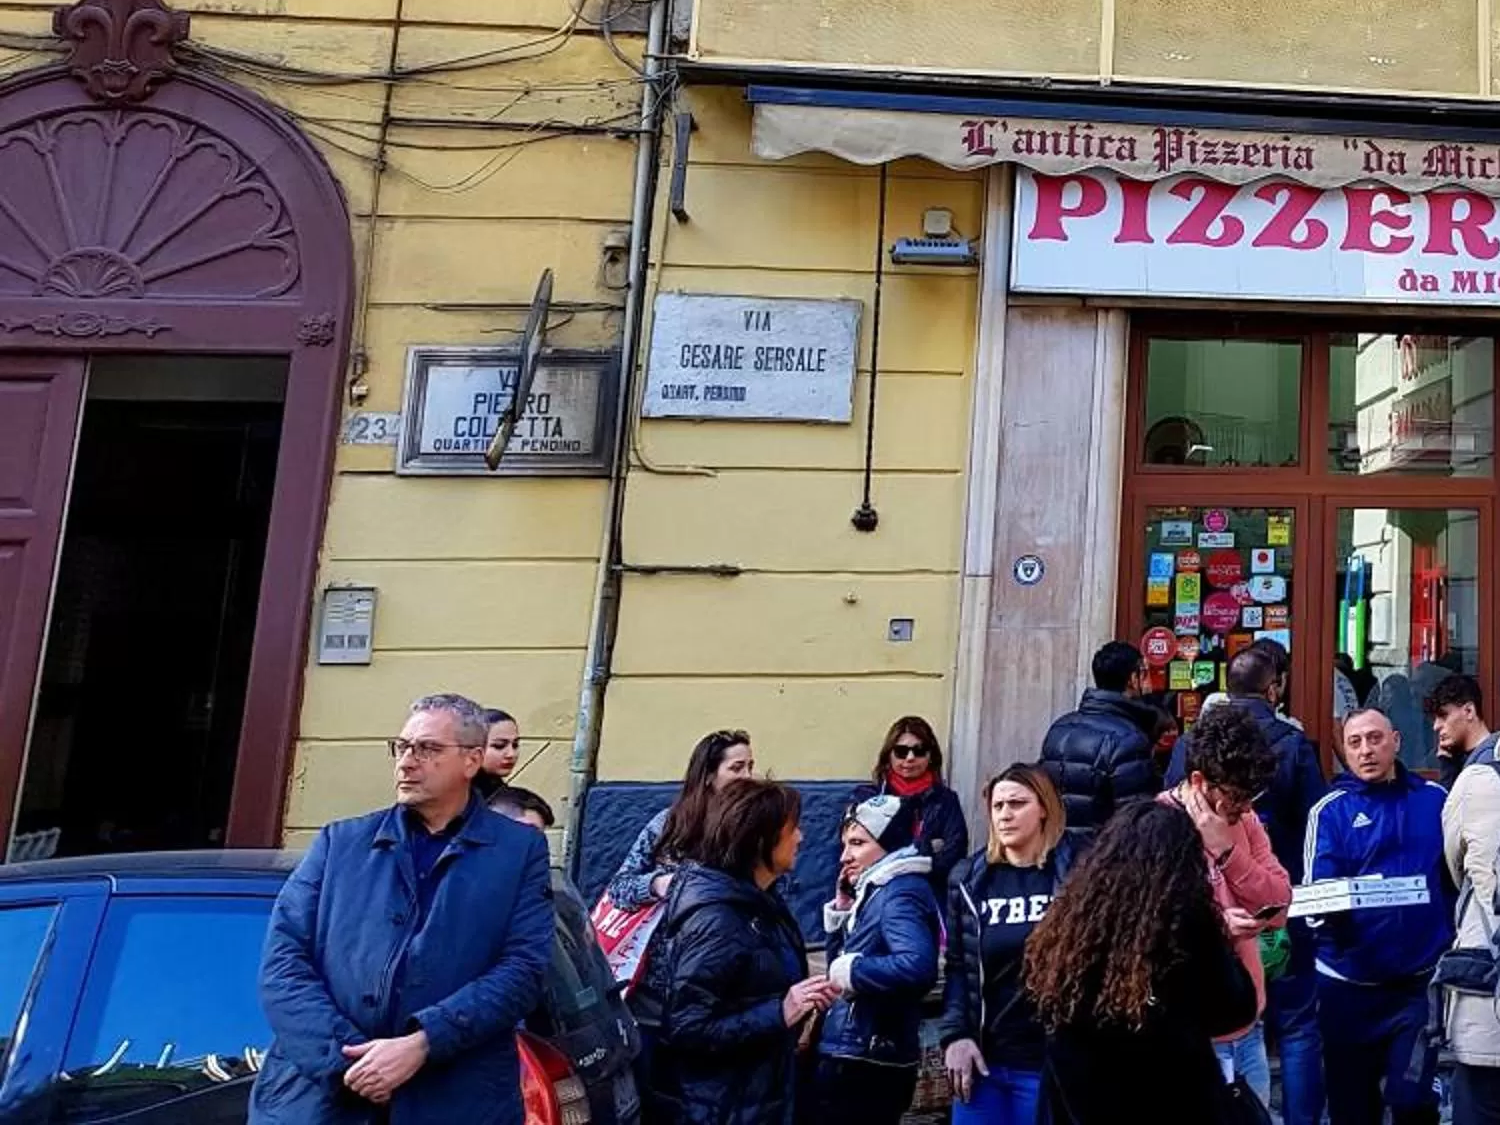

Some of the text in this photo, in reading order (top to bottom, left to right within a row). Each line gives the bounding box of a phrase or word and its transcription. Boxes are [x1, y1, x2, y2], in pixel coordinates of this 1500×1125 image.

[960, 119, 1137, 163] L'antica
[1153, 125, 1314, 172] Pizzeria
[1398, 267, 1440, 294] da
[743, 310, 772, 332] VIA
[680, 343, 827, 373] CESARE SERSALE
[473, 392, 551, 415] PIERO
[454, 416, 563, 438] COLETTA
[433, 439, 581, 452] QUARTIE PENDINO
